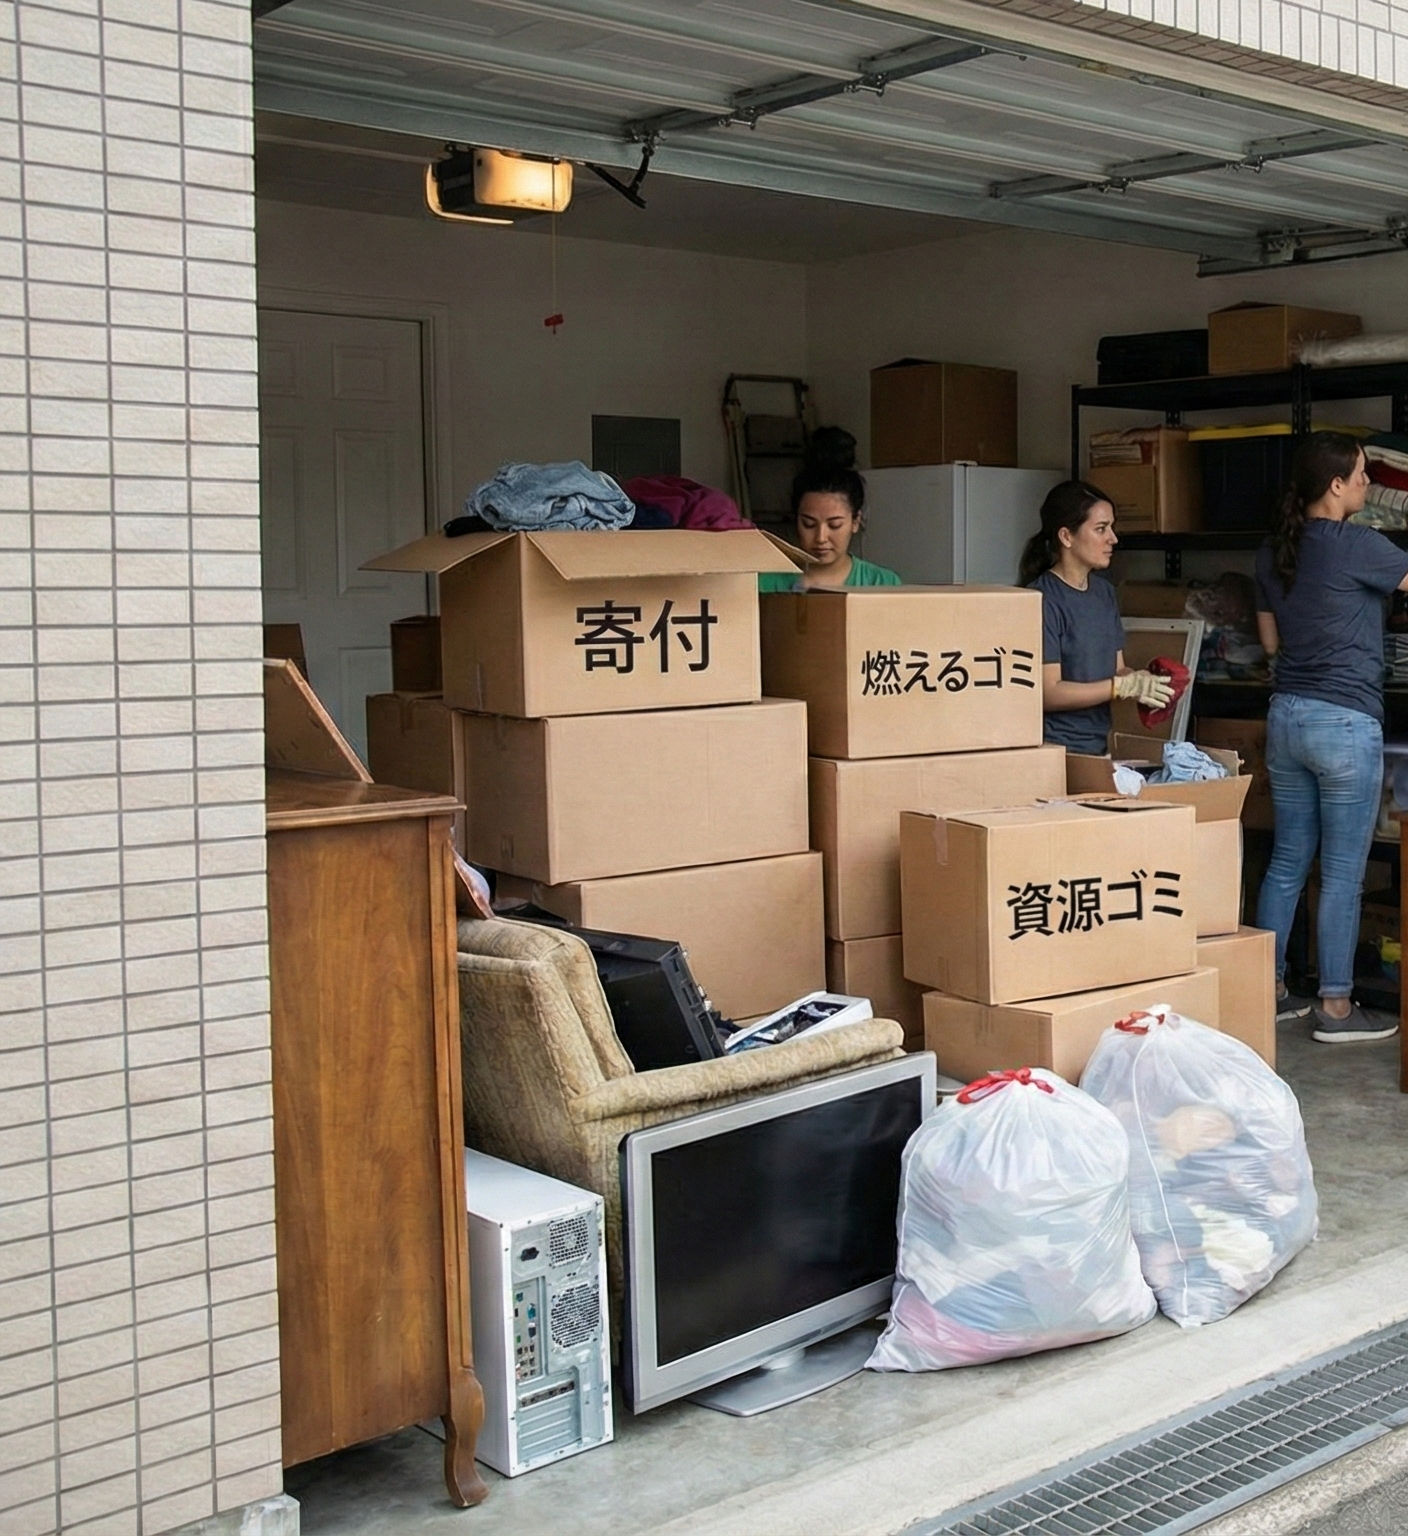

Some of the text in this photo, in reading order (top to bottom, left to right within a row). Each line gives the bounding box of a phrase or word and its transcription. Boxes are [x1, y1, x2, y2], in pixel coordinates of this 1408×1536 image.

[574, 598, 718, 674] 寄付
[861, 646, 1036, 696] 燃えるゴミ
[1006, 869, 1184, 941] 資源ゴミ
